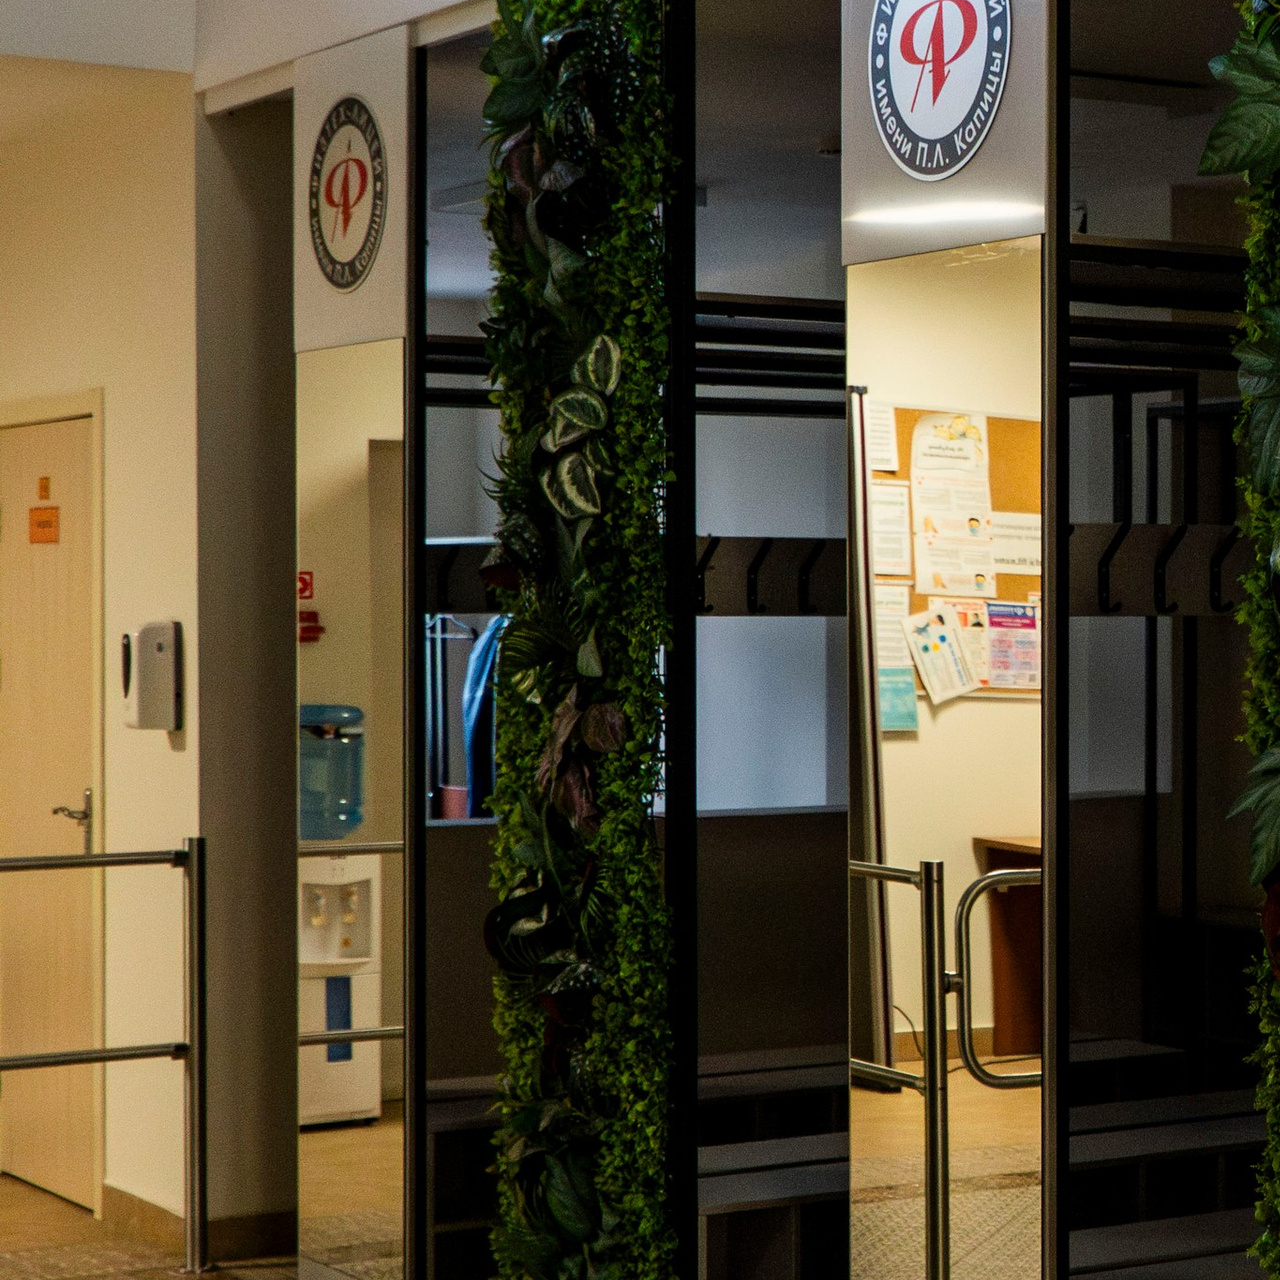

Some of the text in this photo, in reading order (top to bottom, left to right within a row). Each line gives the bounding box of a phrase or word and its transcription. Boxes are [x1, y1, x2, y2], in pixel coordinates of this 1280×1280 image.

[875, 52, 1003, 168] имени П.Л. Капицы
